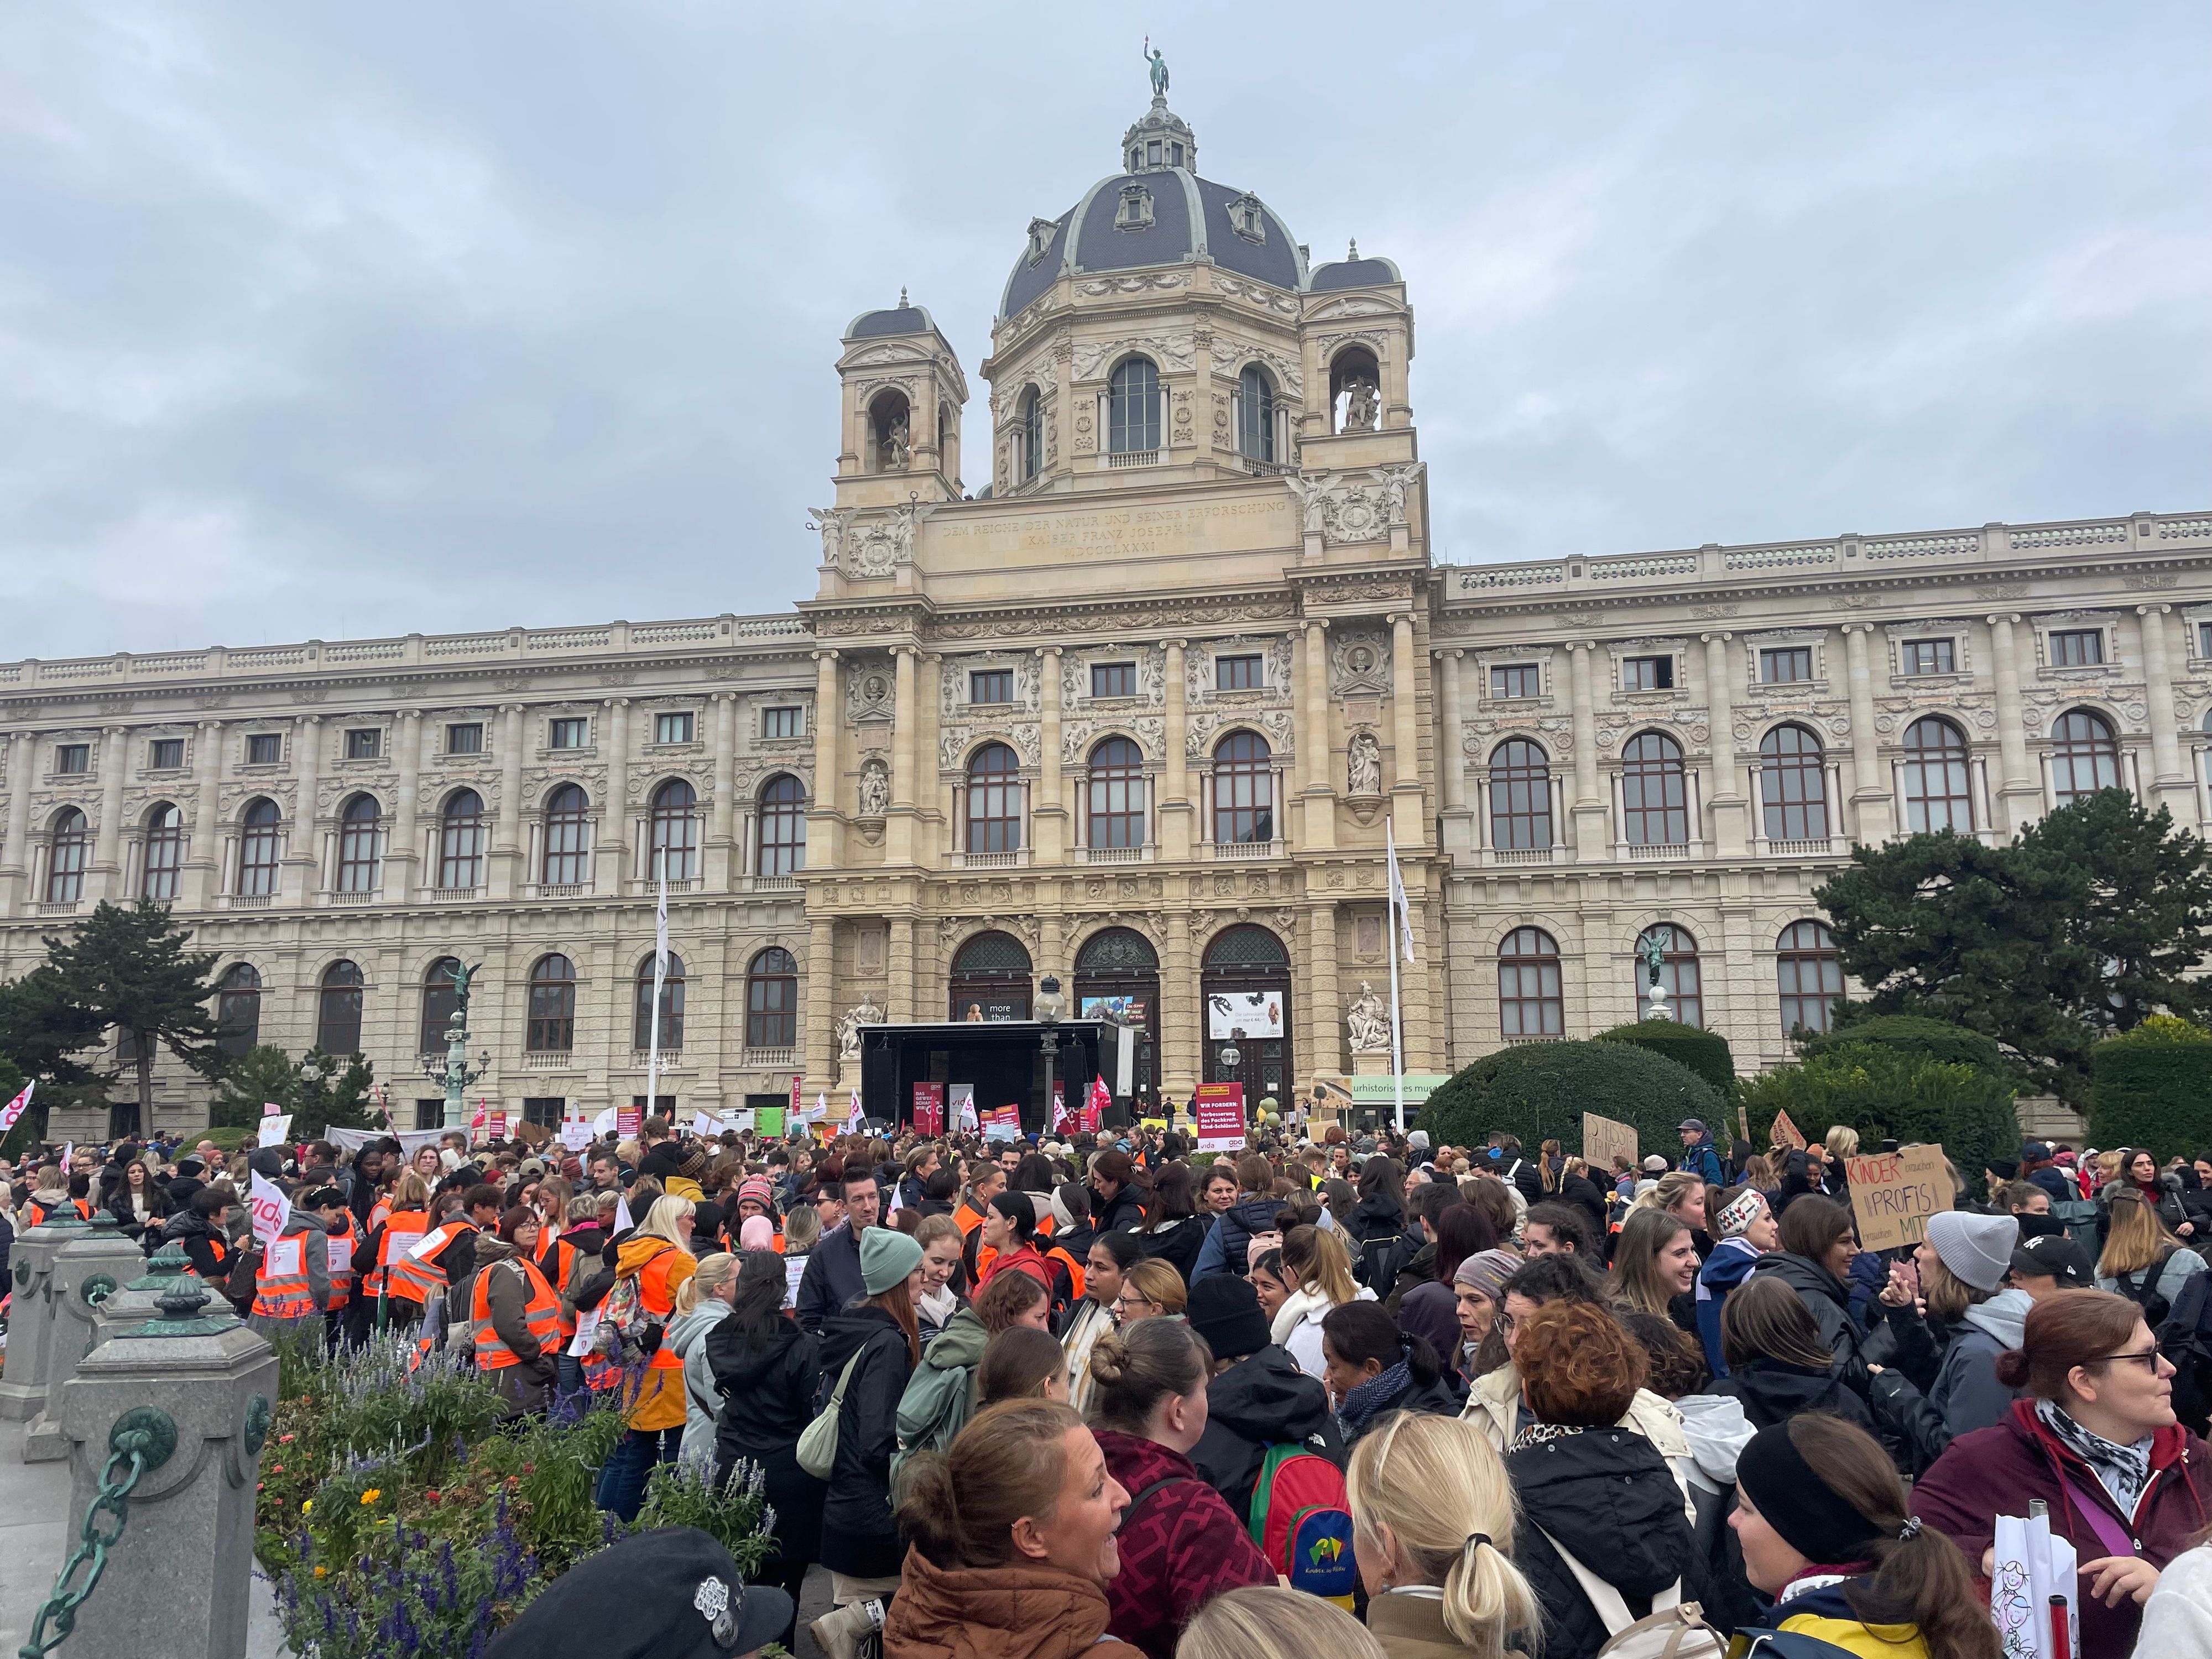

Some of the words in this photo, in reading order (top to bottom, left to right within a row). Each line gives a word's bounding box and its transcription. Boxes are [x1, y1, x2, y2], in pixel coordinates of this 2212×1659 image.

[942, 526, 968, 536] DEM
[974, 523, 1019, 535] REICHE
[1025, 520, 1051, 530] DER
[1056, 517, 1098, 529] NATUR
[1104, 514, 1131, 525] UND
[1136, 510, 1182, 522] SEINER
[1188, 502, 1286, 518] ERFORSCHUNG
[1029, 533, 1077, 545] KAISER
[1082, 529, 1123, 542] FRANZ
[1130, 524, 1182, 538] JOSEPH
[952, 1097, 966, 1106] vid
